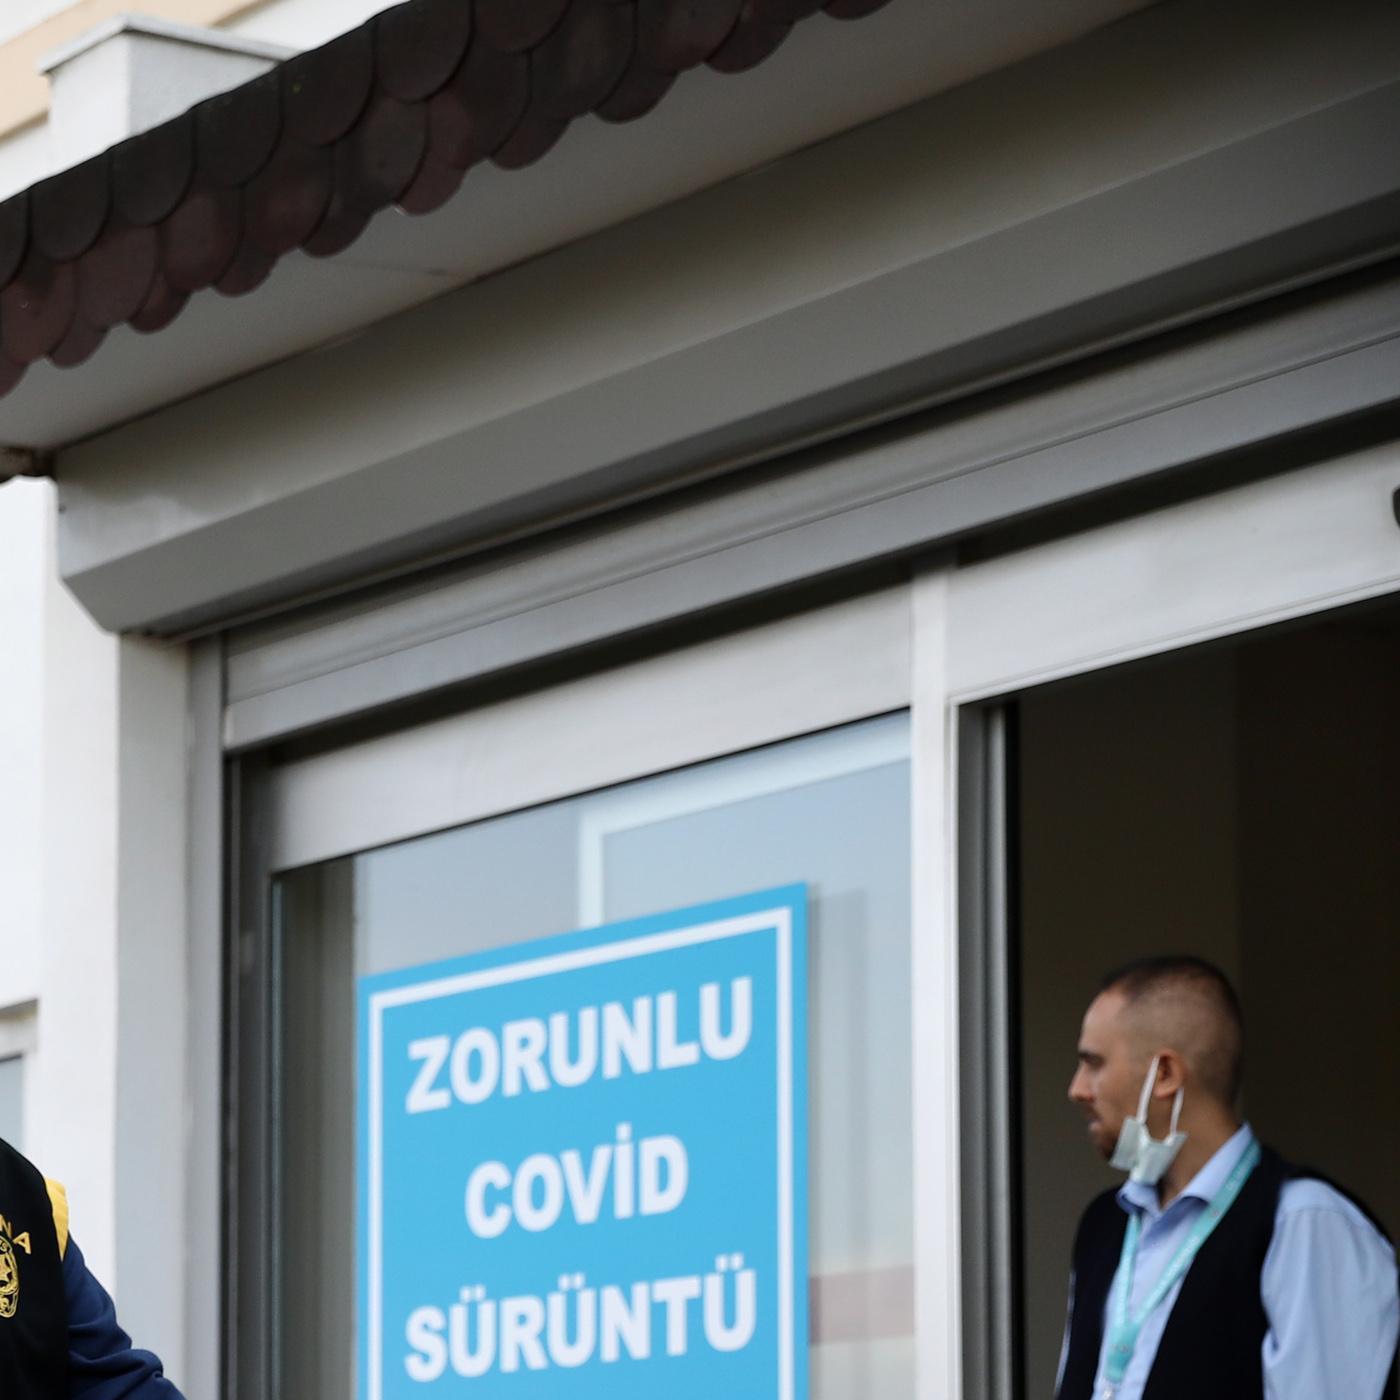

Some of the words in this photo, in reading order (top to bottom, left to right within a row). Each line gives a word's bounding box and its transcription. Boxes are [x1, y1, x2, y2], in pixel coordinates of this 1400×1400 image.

[405, 976, 752, 1114] ZORUNLU
[464, 1122, 688, 1239] COVİD
[404, 1252, 757, 1383] SÜRÜNTÜ
